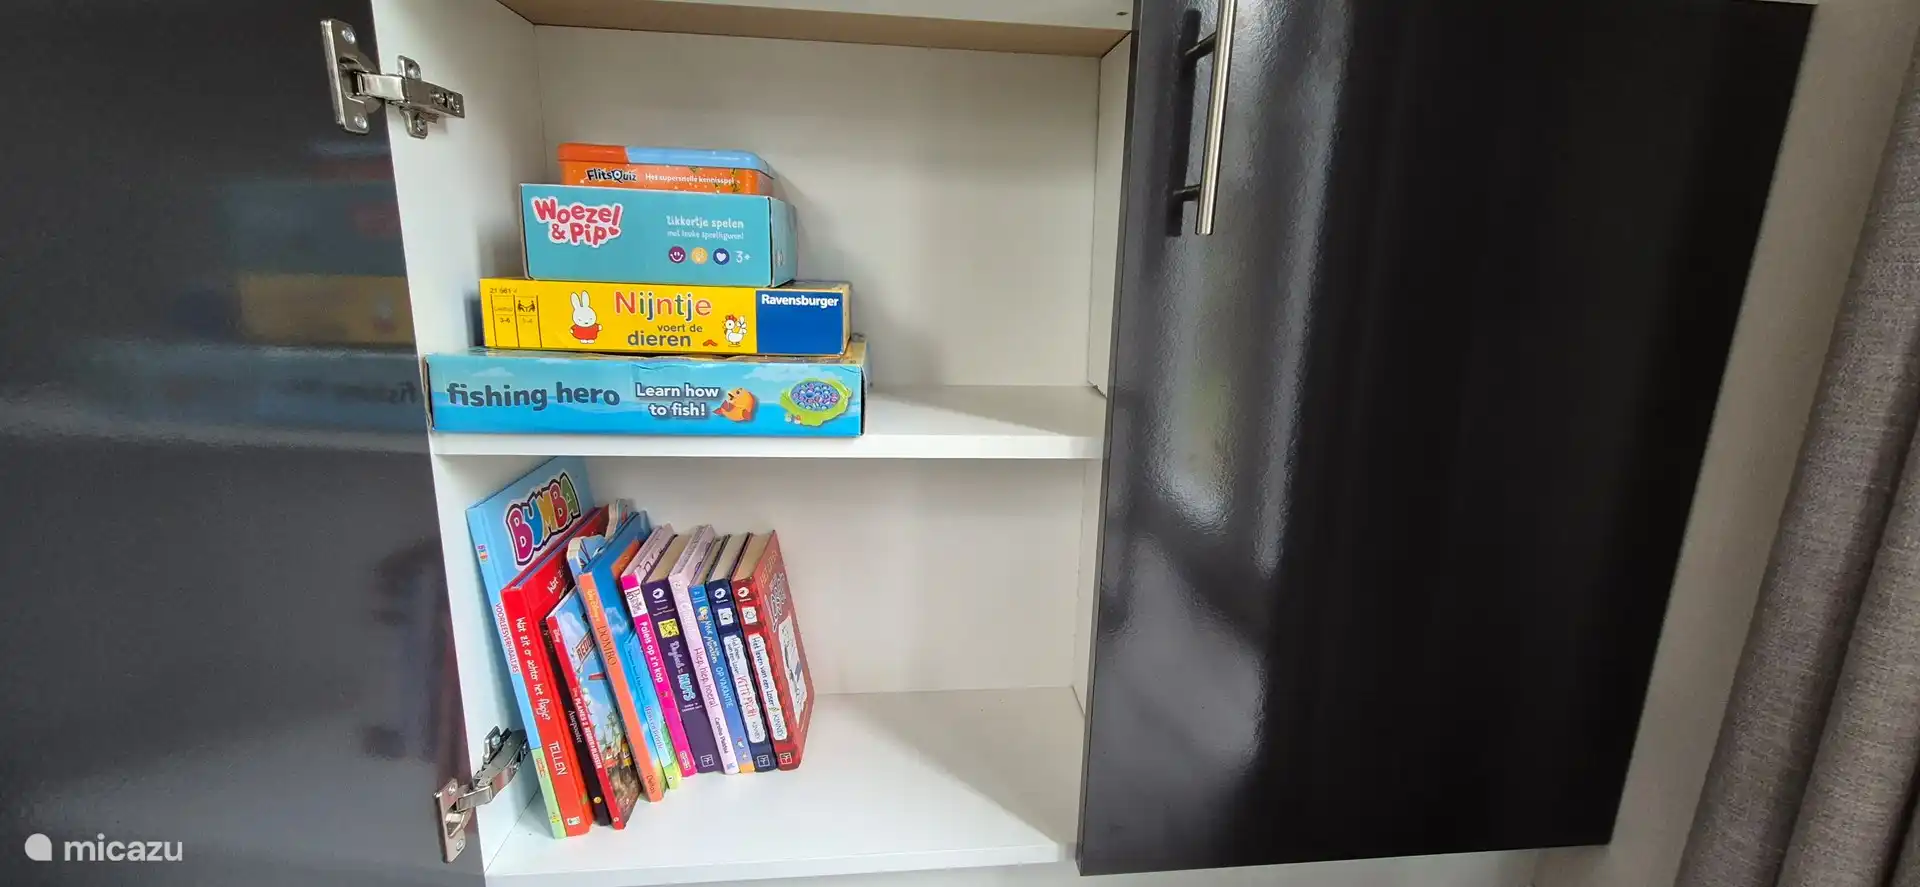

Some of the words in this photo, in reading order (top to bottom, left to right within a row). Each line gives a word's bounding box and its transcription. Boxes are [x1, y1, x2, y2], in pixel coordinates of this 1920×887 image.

[587, 168, 637, 184] FlitsQuiz
[645, 173, 658, 181] Het
[659, 173, 698, 184] supersnelle
[533, 198, 622, 226] Woezel
[711, 217, 745, 230] spelen
[551, 223, 566, 240] &
[570, 222, 608, 247] Pip
[735, 250, 751, 264] 3+
[615, 290, 712, 322] Nijntje
[761, 294, 839, 309] Ravensburger
[657, 323, 686, 333] voert
[689, 324, 703, 333] de
[627, 330, 691, 347] dieren
[446, 381, 547, 411] fishing
[556, 381, 620, 407] hero
[635, 382, 681, 398] Learn
[684, 384, 720, 399] how
[649, 402, 668, 417] to
[670, 401, 706, 418] fish!
[505, 472, 581, 566] BUMBA
[493, 602, 519, 674] VOORLEESVERHAALTJES
[637, 621, 653, 644] Paleis
[595, 624, 618, 667] DOMBO
[644, 644, 655, 656] op
[751, 636, 763, 649] Het
[649, 654, 660, 668] z'n
[755, 649, 766, 666] leven
[526, 658, 541, 681] achter
[652, 666, 666, 683] kop
[715, 665, 725, 677] OP
[759, 665, 767, 678] van
[533, 682, 544, 696] het
[718, 676, 733, 708] VAKANTIE
[765, 689, 776, 706] Loser
[573, 697, 586, 721] PLANES
[565, 708, 584, 744] Assepoester
[546, 740, 567, 776] TELLEN
